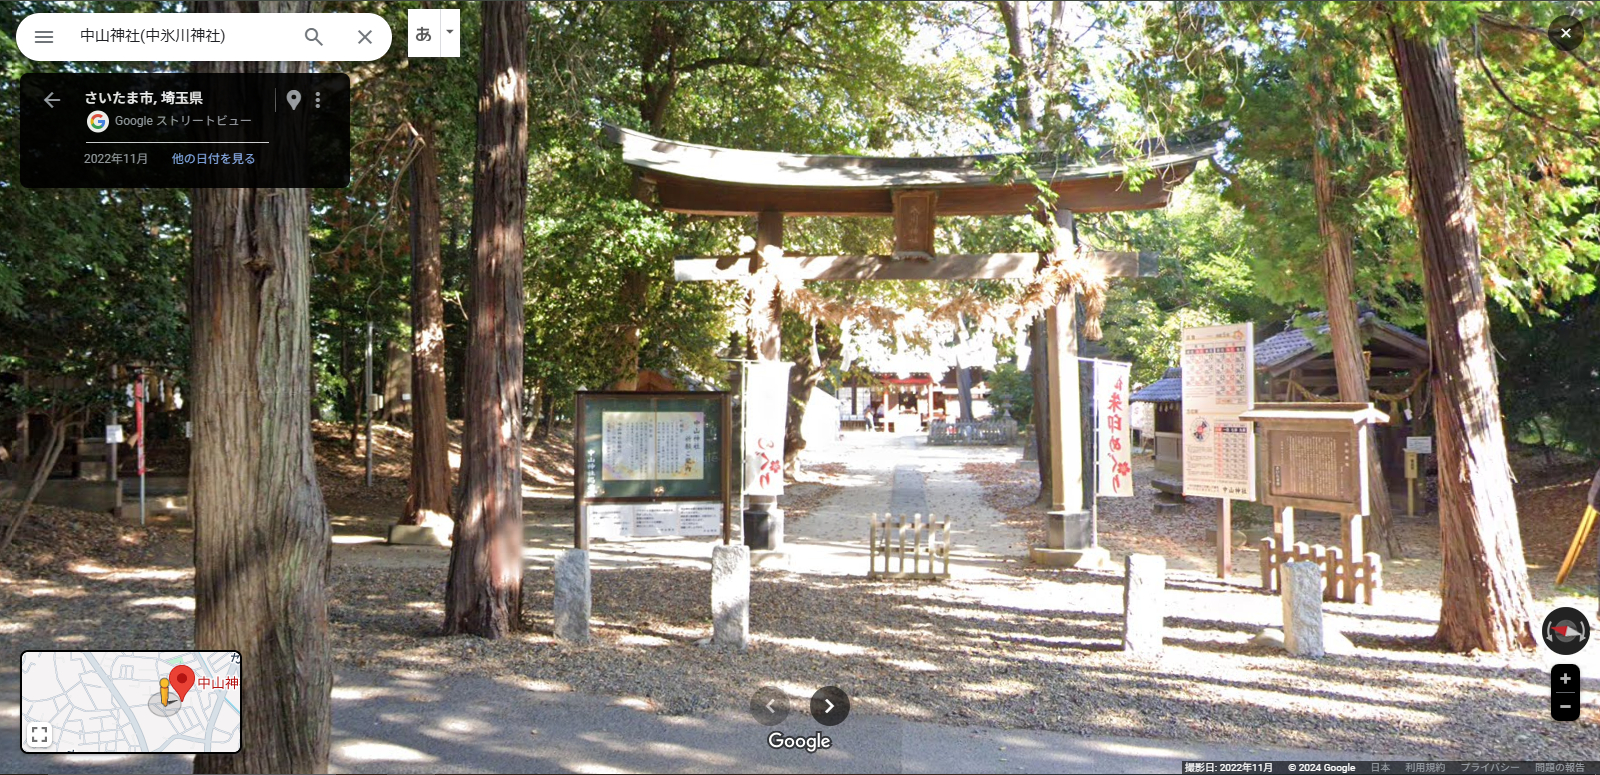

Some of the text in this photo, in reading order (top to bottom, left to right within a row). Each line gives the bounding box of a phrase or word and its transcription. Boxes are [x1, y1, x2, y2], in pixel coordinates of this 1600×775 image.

[693, 419, 701, 450] 中山神社
[1222, 486, 1247, 495] 中山神社
